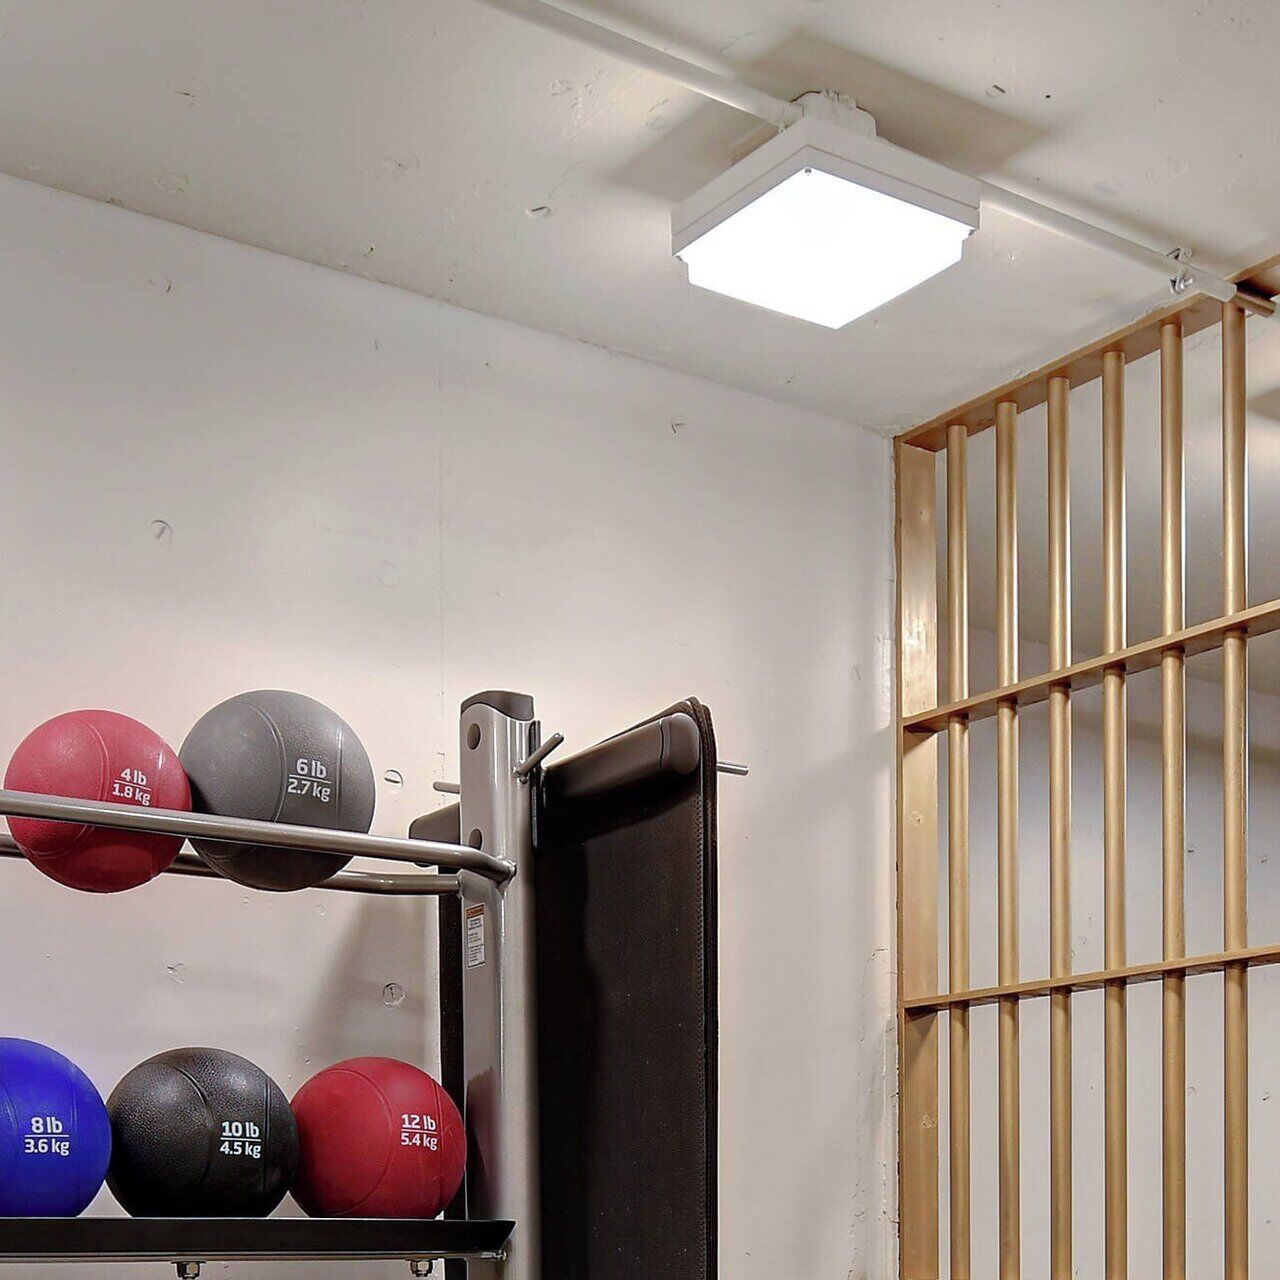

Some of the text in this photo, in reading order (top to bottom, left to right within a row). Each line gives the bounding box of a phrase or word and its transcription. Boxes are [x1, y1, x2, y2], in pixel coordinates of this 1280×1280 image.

[120, 768, 147, 785] 4 lb
[296, 758, 327, 778] 6 lb
[111, 783, 151, 806] 1.8 kg
[287, 778, 331, 803] 2.7 kg
[30, 1116, 63, 1134] 8 lb
[221, 1121, 260, 1138] 10 lb
[401, 1113, 436, 1130] 12 lb
[24, 1138, 70, 1156] 3.6 kg
[219, 1141, 262, 1159] 4.5 kg
[400, 1132, 438, 1151] 5.4 kg
